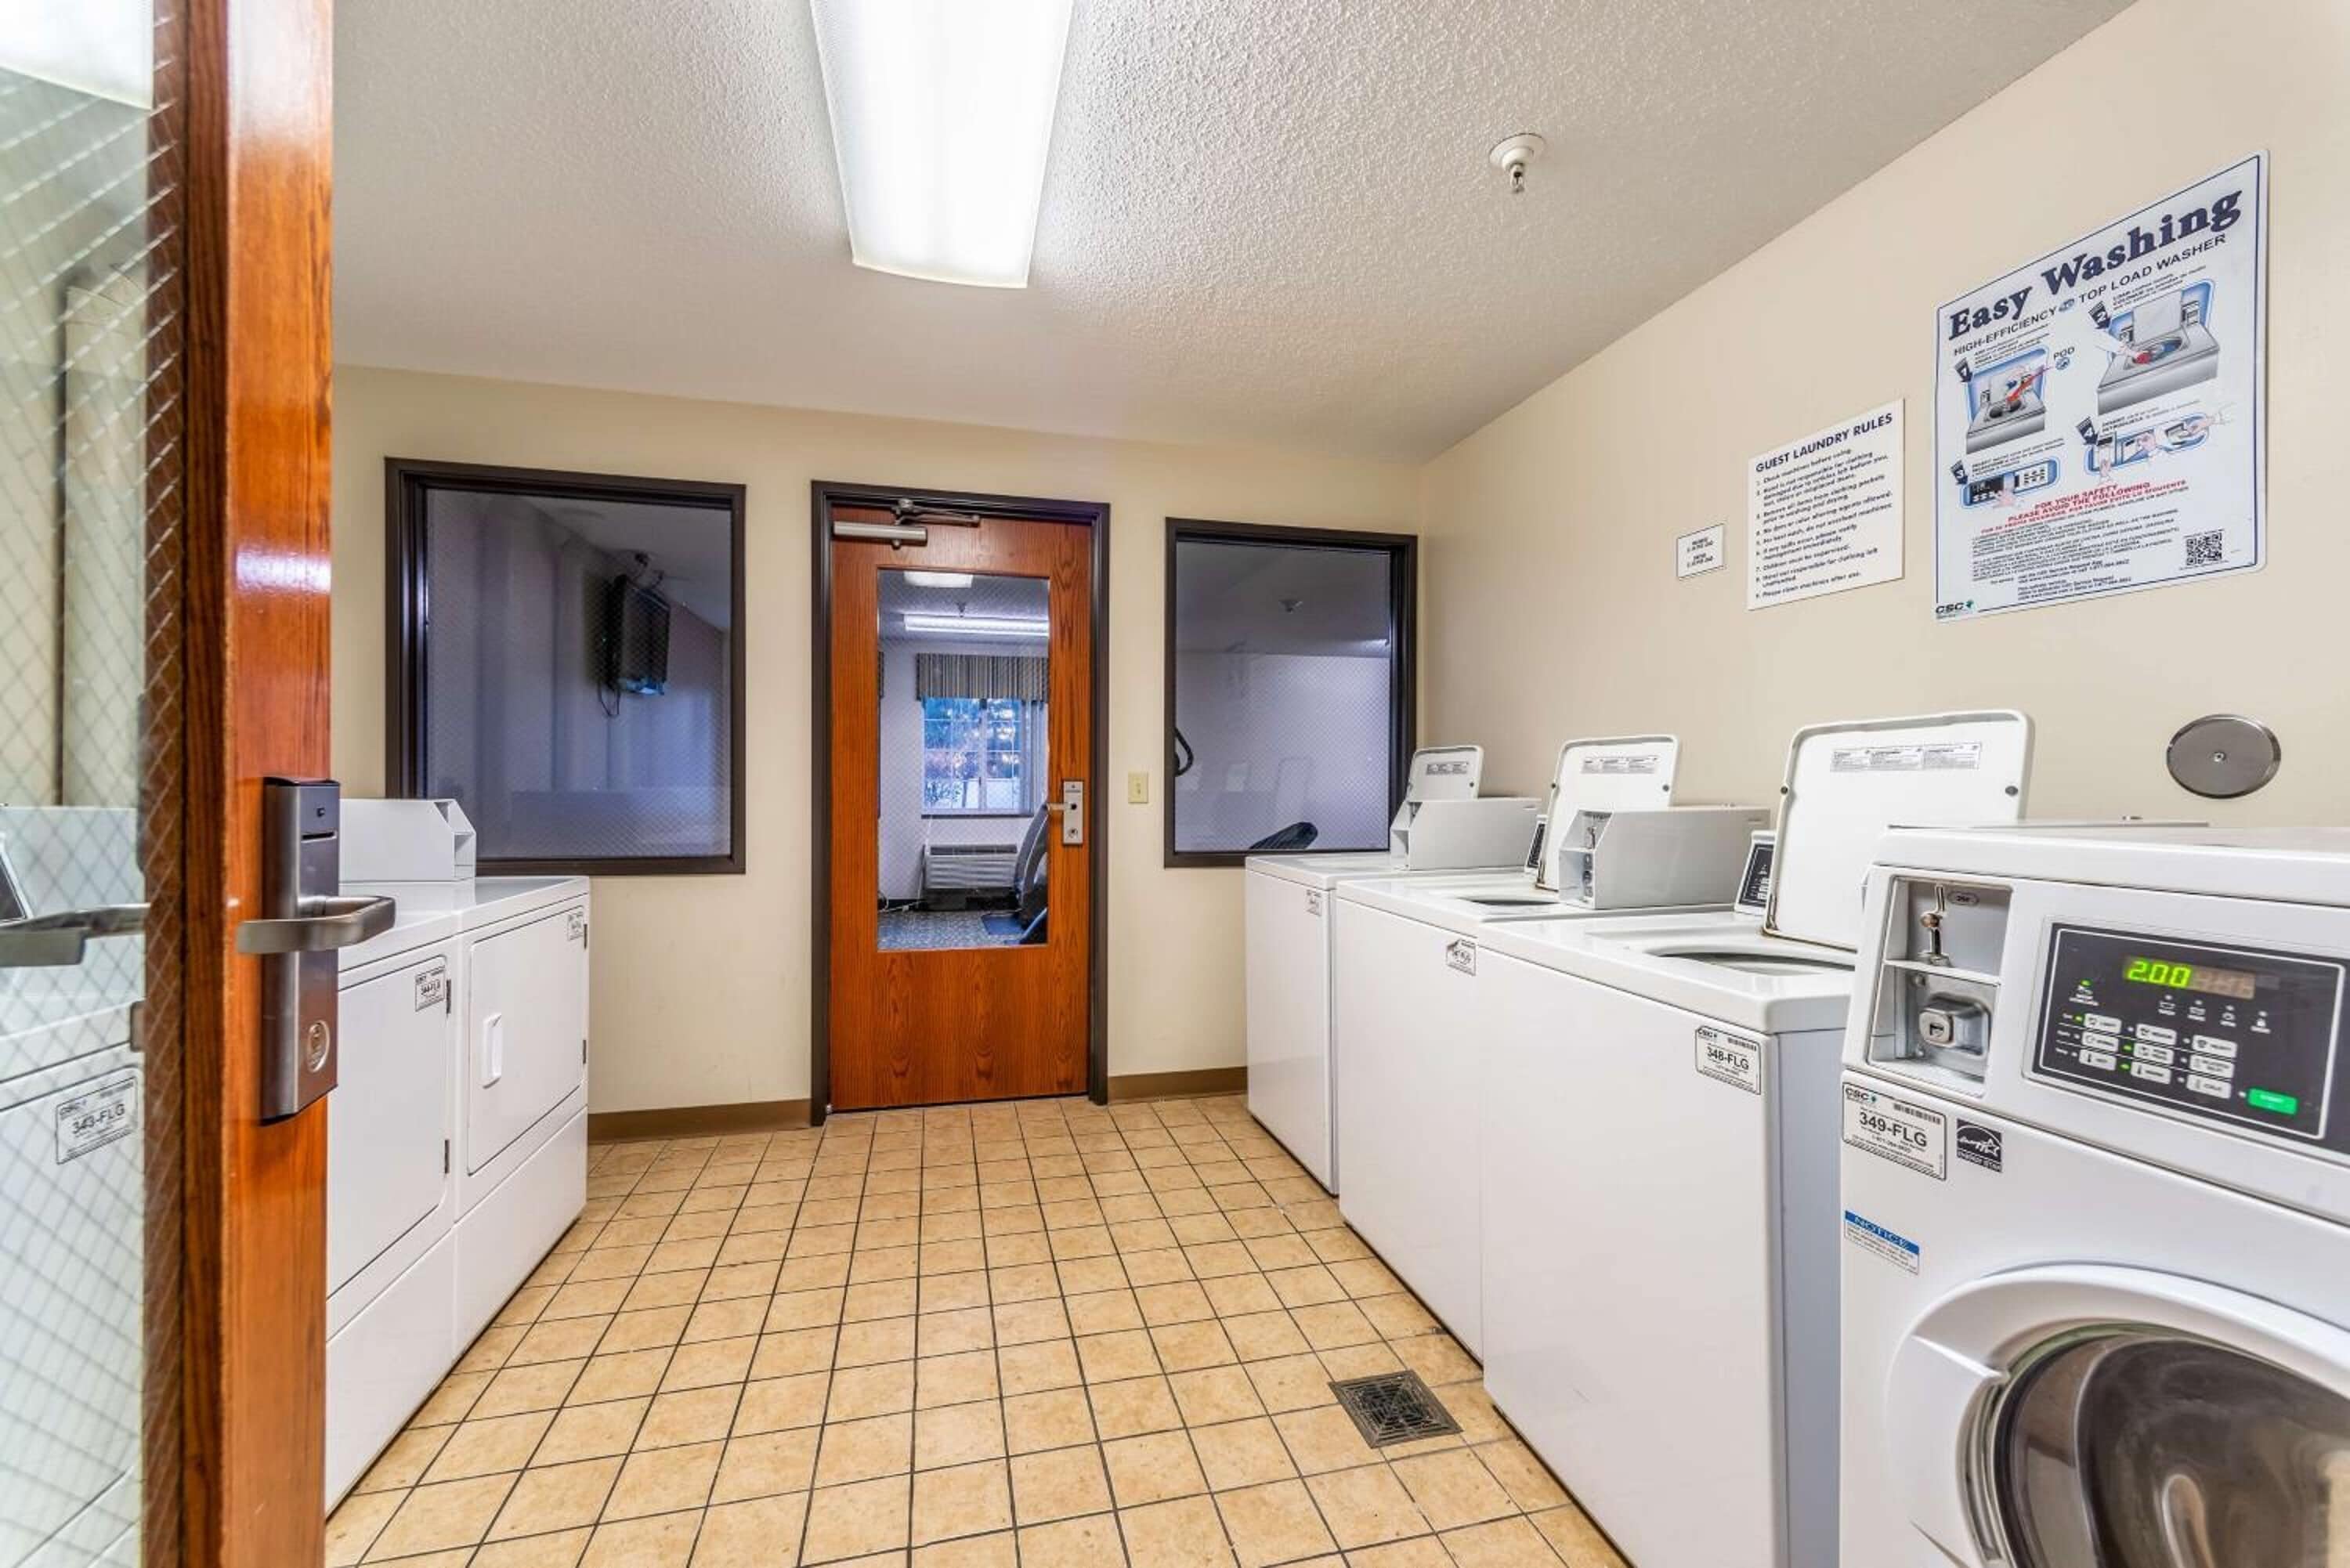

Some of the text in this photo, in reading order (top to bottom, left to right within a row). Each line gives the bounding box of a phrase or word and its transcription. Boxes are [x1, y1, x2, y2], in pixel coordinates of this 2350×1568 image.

[1949, 287, 2032, 340] Easy
[2041, 190, 2242, 294] Washing
[1954, 307, 2058, 356] HIGH-EFFICIENCY
[2078, 286, 2107, 304] TOP
[2110, 266, 2152, 291] LOAD
[2157, 233, 2226, 269] WASHER
[2054, 346, 2075, 360] POD
[1755, 413, 1893, 472] GUEST LAUNDRY RULES
[1935, 602, 1965, 614] CSC
[1707, 1046, 1749, 1071] 348-FLG
[1845, 1086, 1869, 1101] CSC
[1859, 1111, 1928, 1148] 349-FLG
